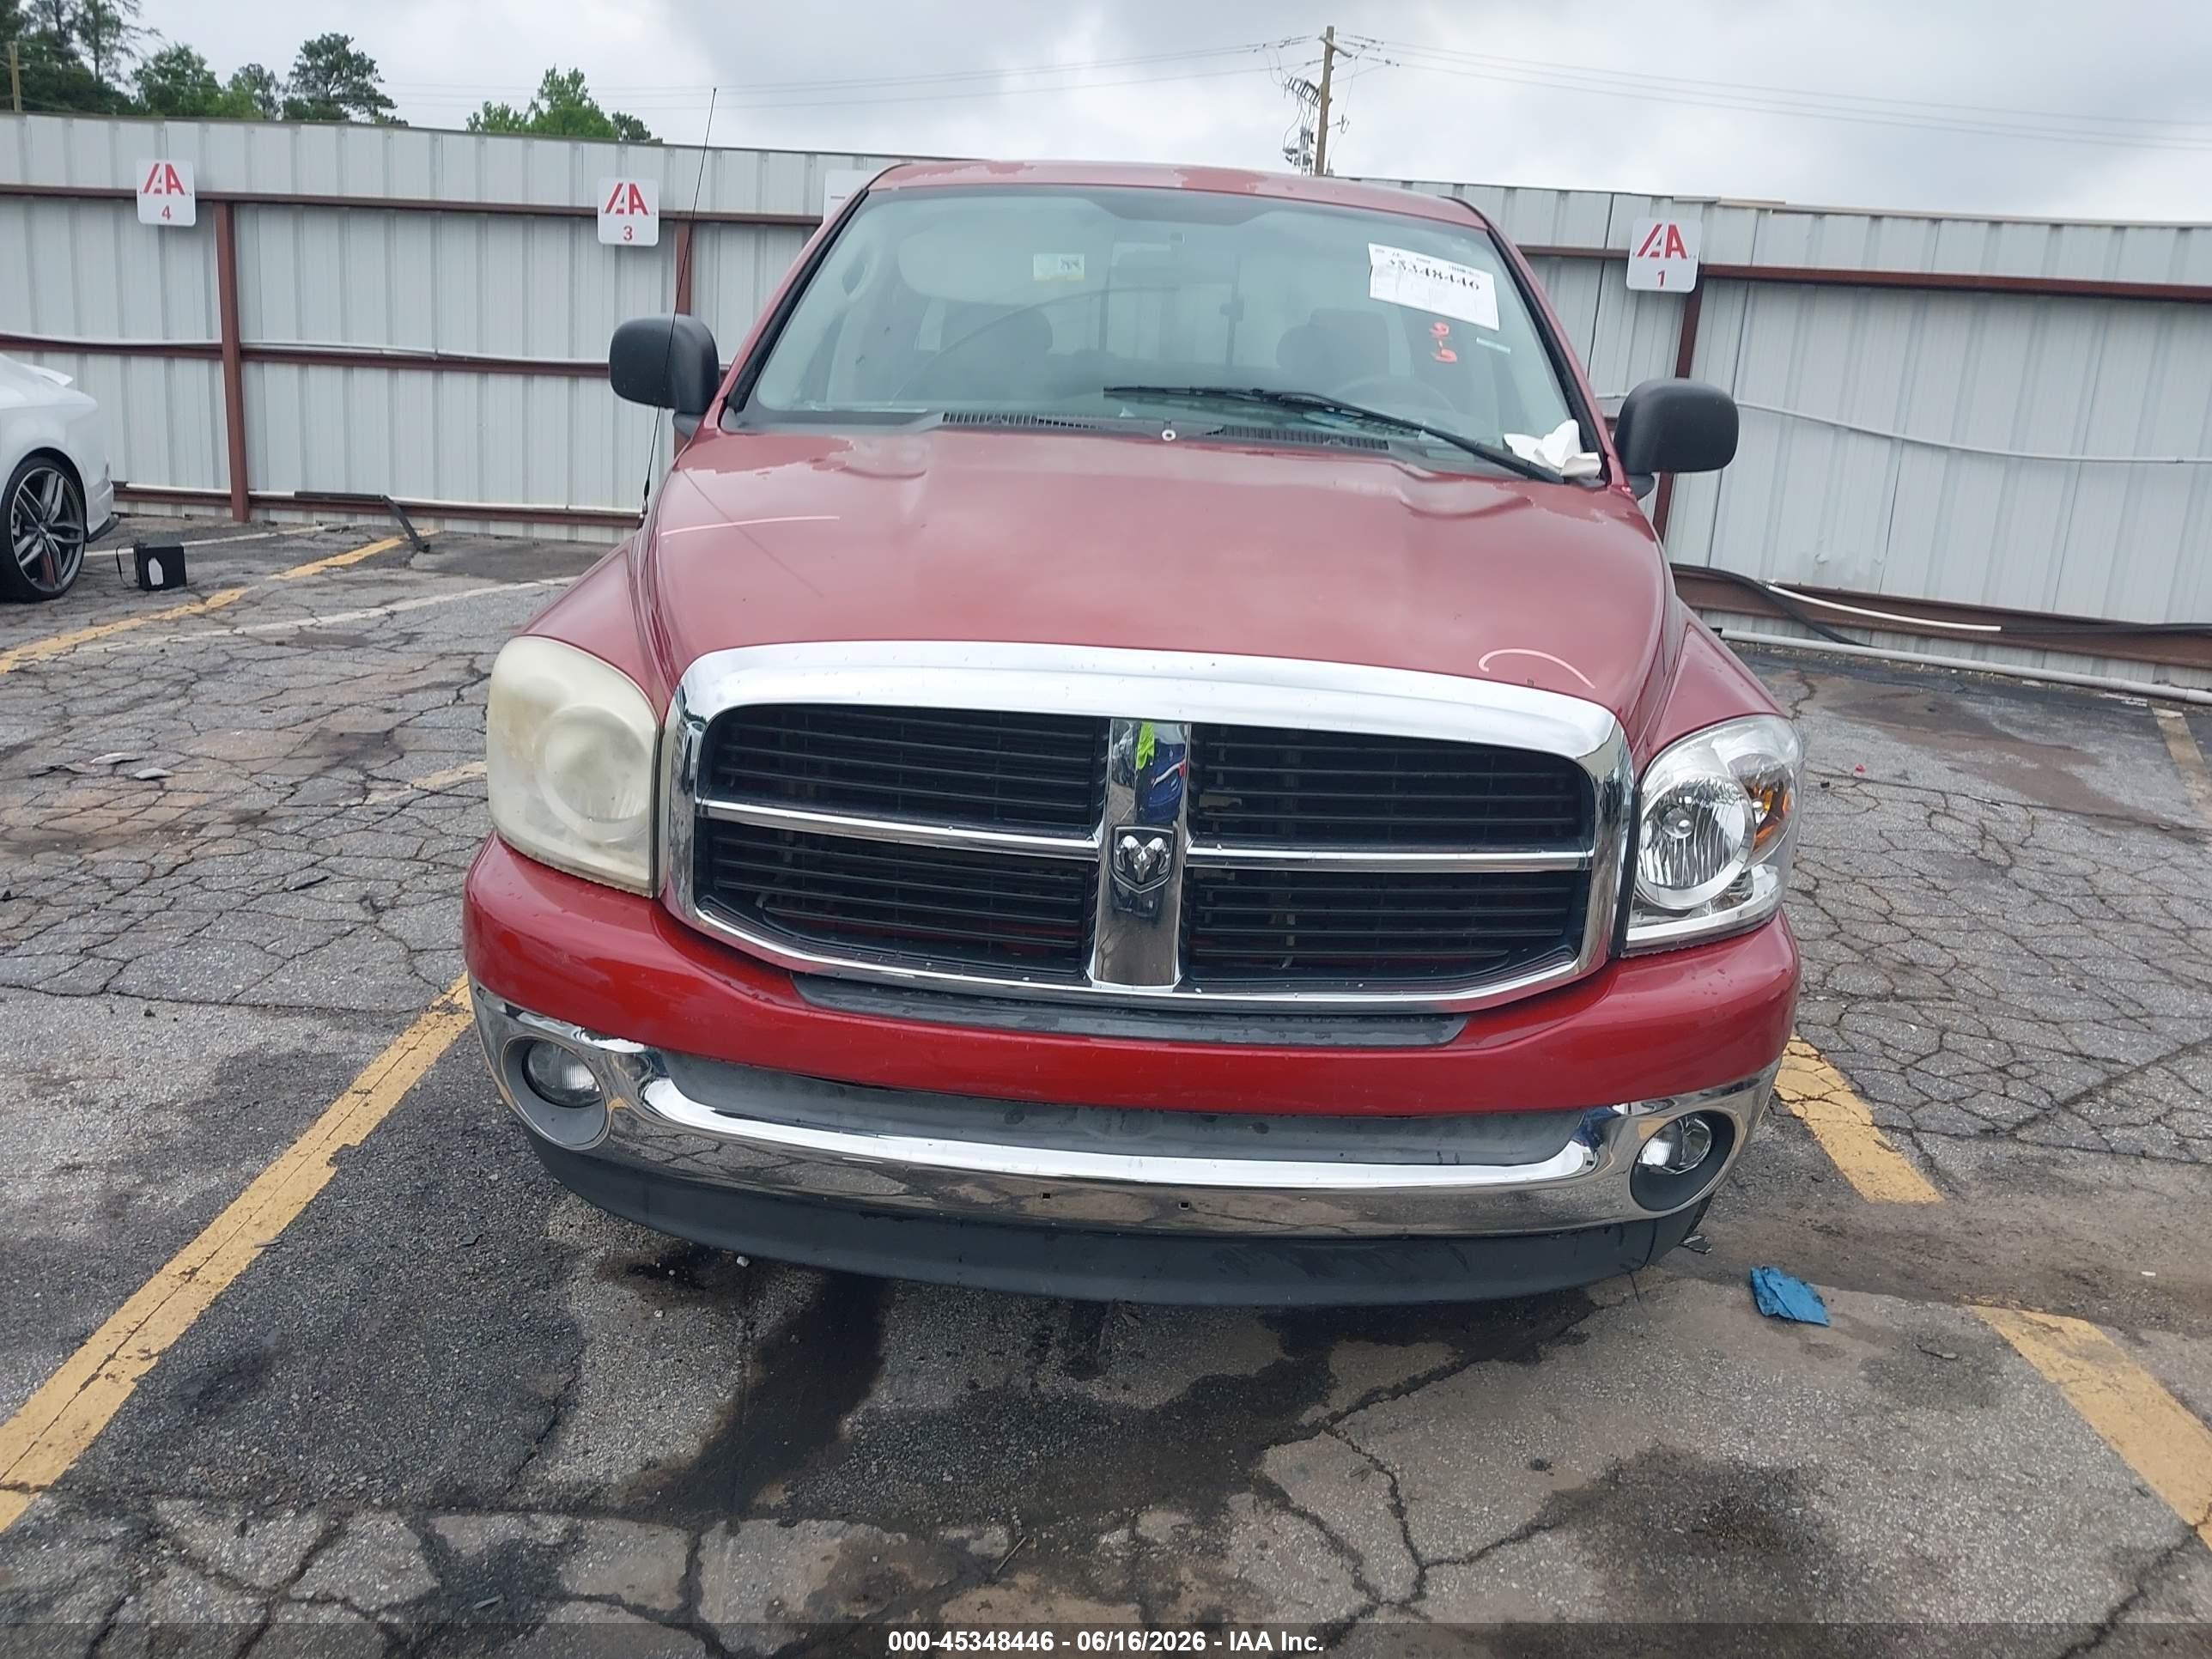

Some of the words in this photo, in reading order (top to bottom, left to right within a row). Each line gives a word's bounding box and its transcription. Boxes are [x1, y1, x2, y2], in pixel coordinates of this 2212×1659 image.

[161, 205, 172, 220] 4
[623, 226, 633, 241] 3
[1657, 270, 1666, 288] 1
